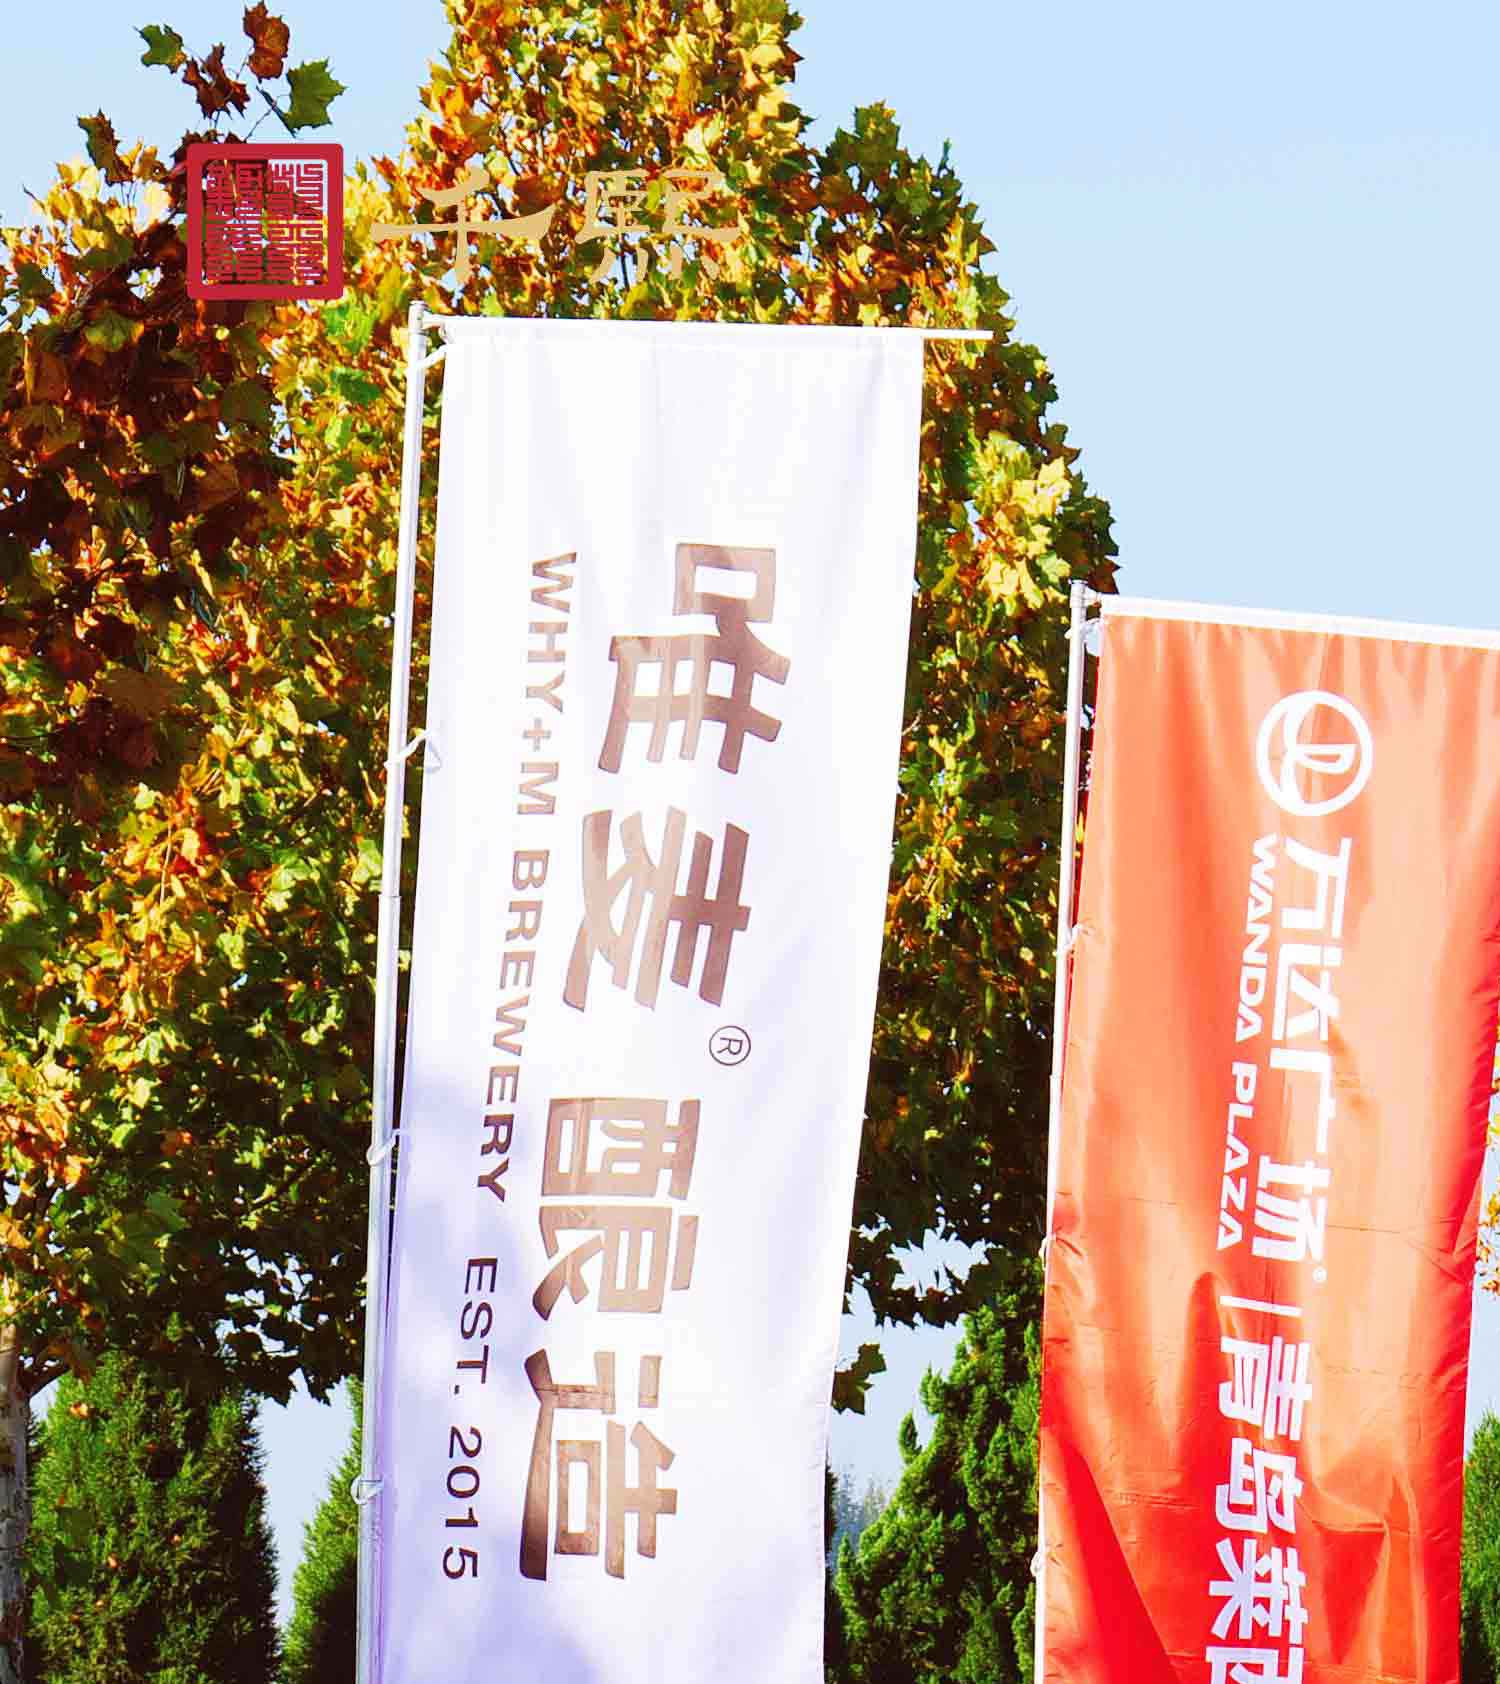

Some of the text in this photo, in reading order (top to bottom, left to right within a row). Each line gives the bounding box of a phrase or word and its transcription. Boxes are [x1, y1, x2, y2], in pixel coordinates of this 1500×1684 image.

[517, 551, 577, 815] WHY+M
[477, 848, 549, 1202] BREWERY
[1217, 832, 1278, 1251] WANDA PLAZA
[443, 1425, 485, 1579] 2015
